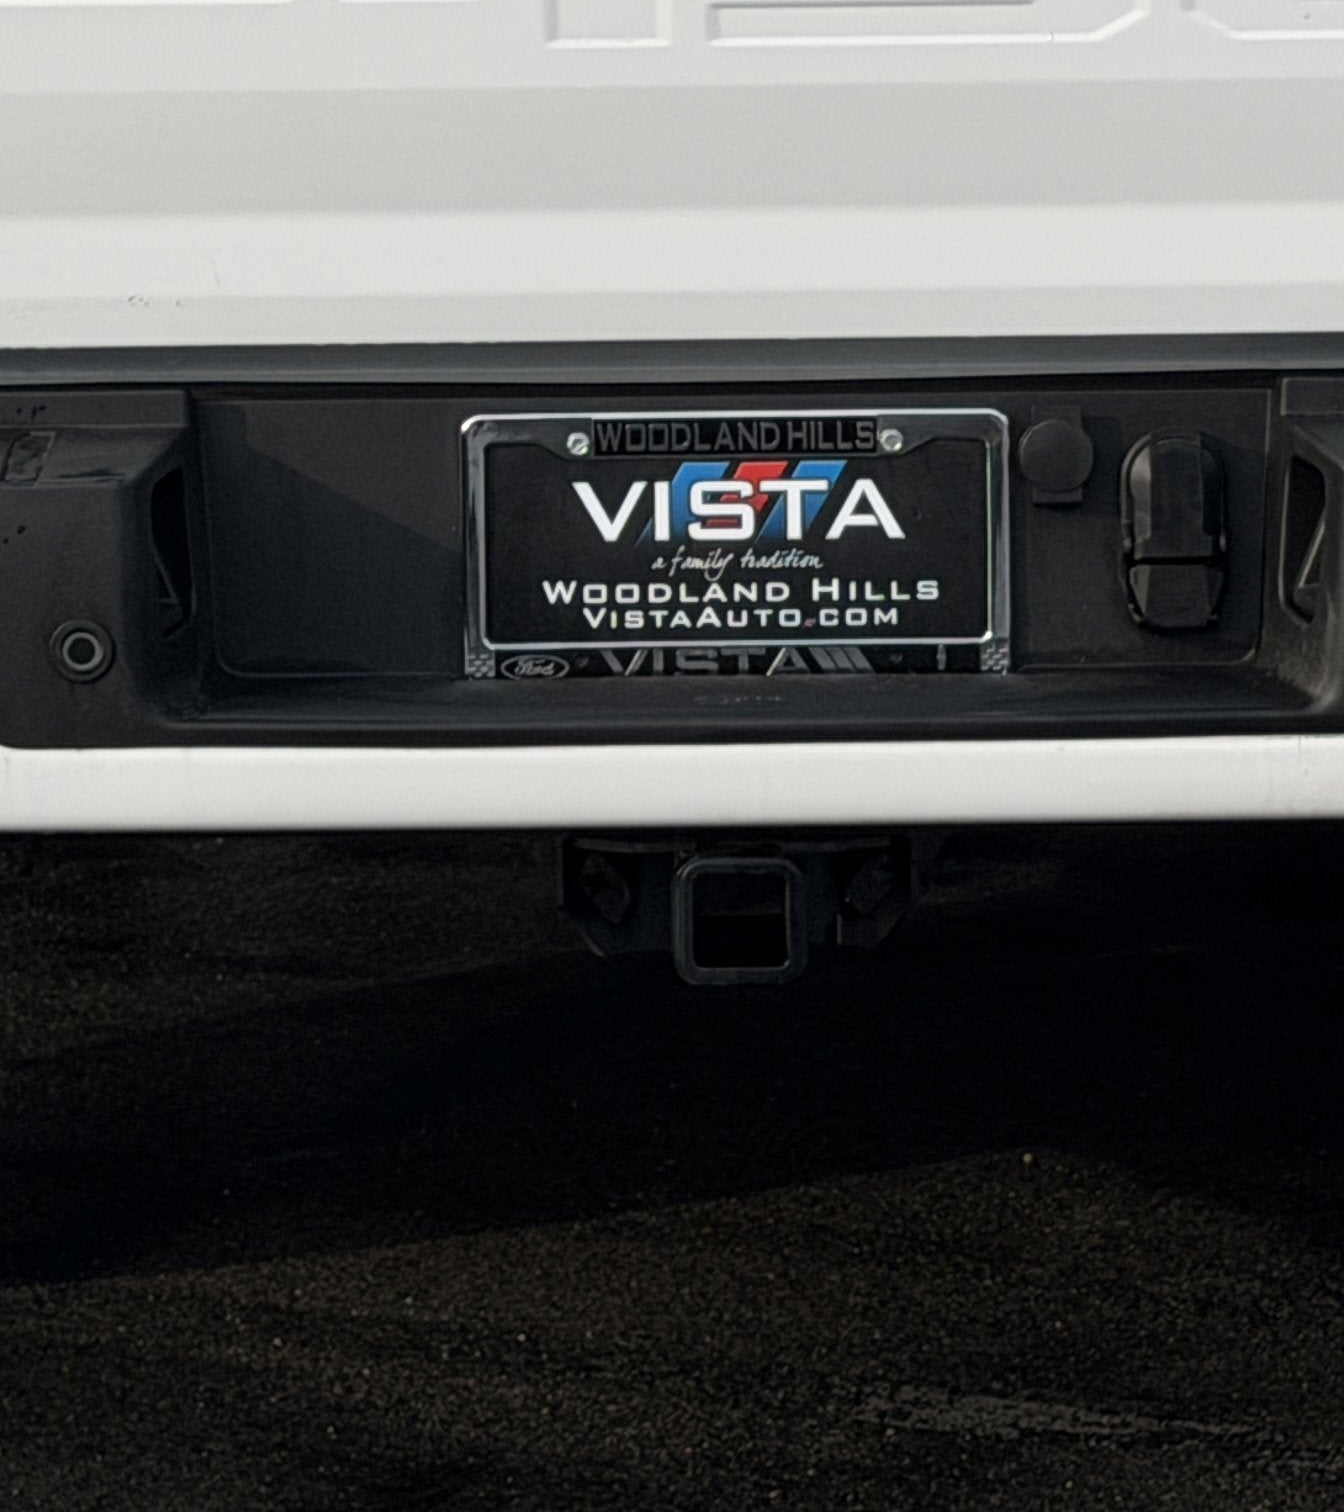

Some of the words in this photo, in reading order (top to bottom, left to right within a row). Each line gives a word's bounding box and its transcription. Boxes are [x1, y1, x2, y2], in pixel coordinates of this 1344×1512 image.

[596, 421, 781, 453] WOODLAND
[786, 420, 874, 451] HILLS
[571, 478, 906, 543] VISTA
[651, 556, 666, 570] a
[668, 544, 735, 582] family
[740, 546, 823, 570] tradition
[542, 579, 791, 605] WOODLAND
[811, 577, 940, 602] HILLS
[600, 647, 810, 677] VISTA
